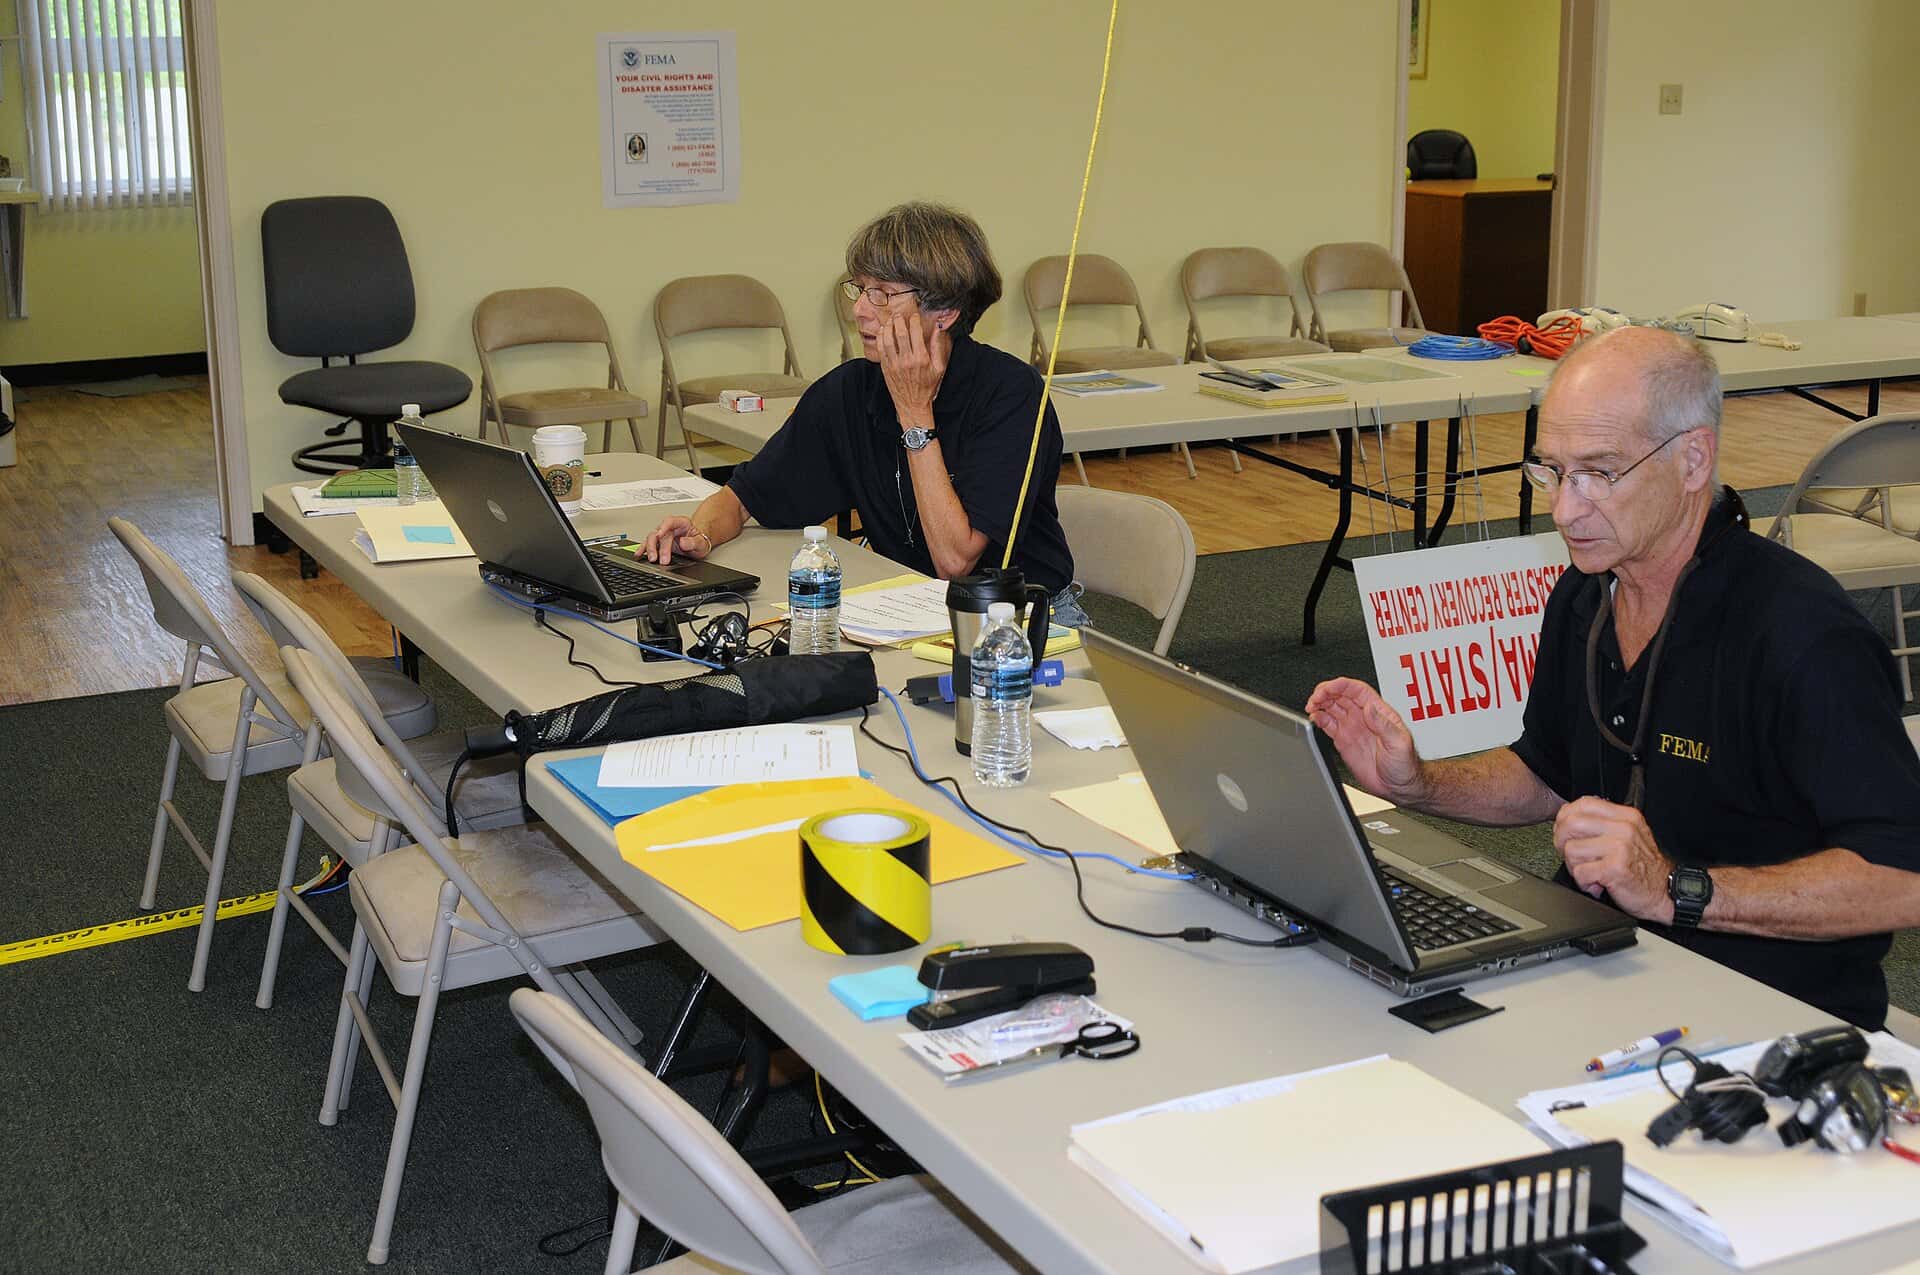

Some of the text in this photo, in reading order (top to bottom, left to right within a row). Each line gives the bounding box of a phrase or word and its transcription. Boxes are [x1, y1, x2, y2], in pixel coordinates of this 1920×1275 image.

[645, 54, 676, 65] FEMA
[616, 74, 639, 82] YOUR
[641, 73, 661, 81] CIVIL
[664, 73, 694, 81] RIGHTS
[663, 84, 713, 92] ASSISTANCE
[1369, 564, 1565, 638] SASTER RECOVERY CENTER
[1400, 625, 1542, 721] MA/STATE
